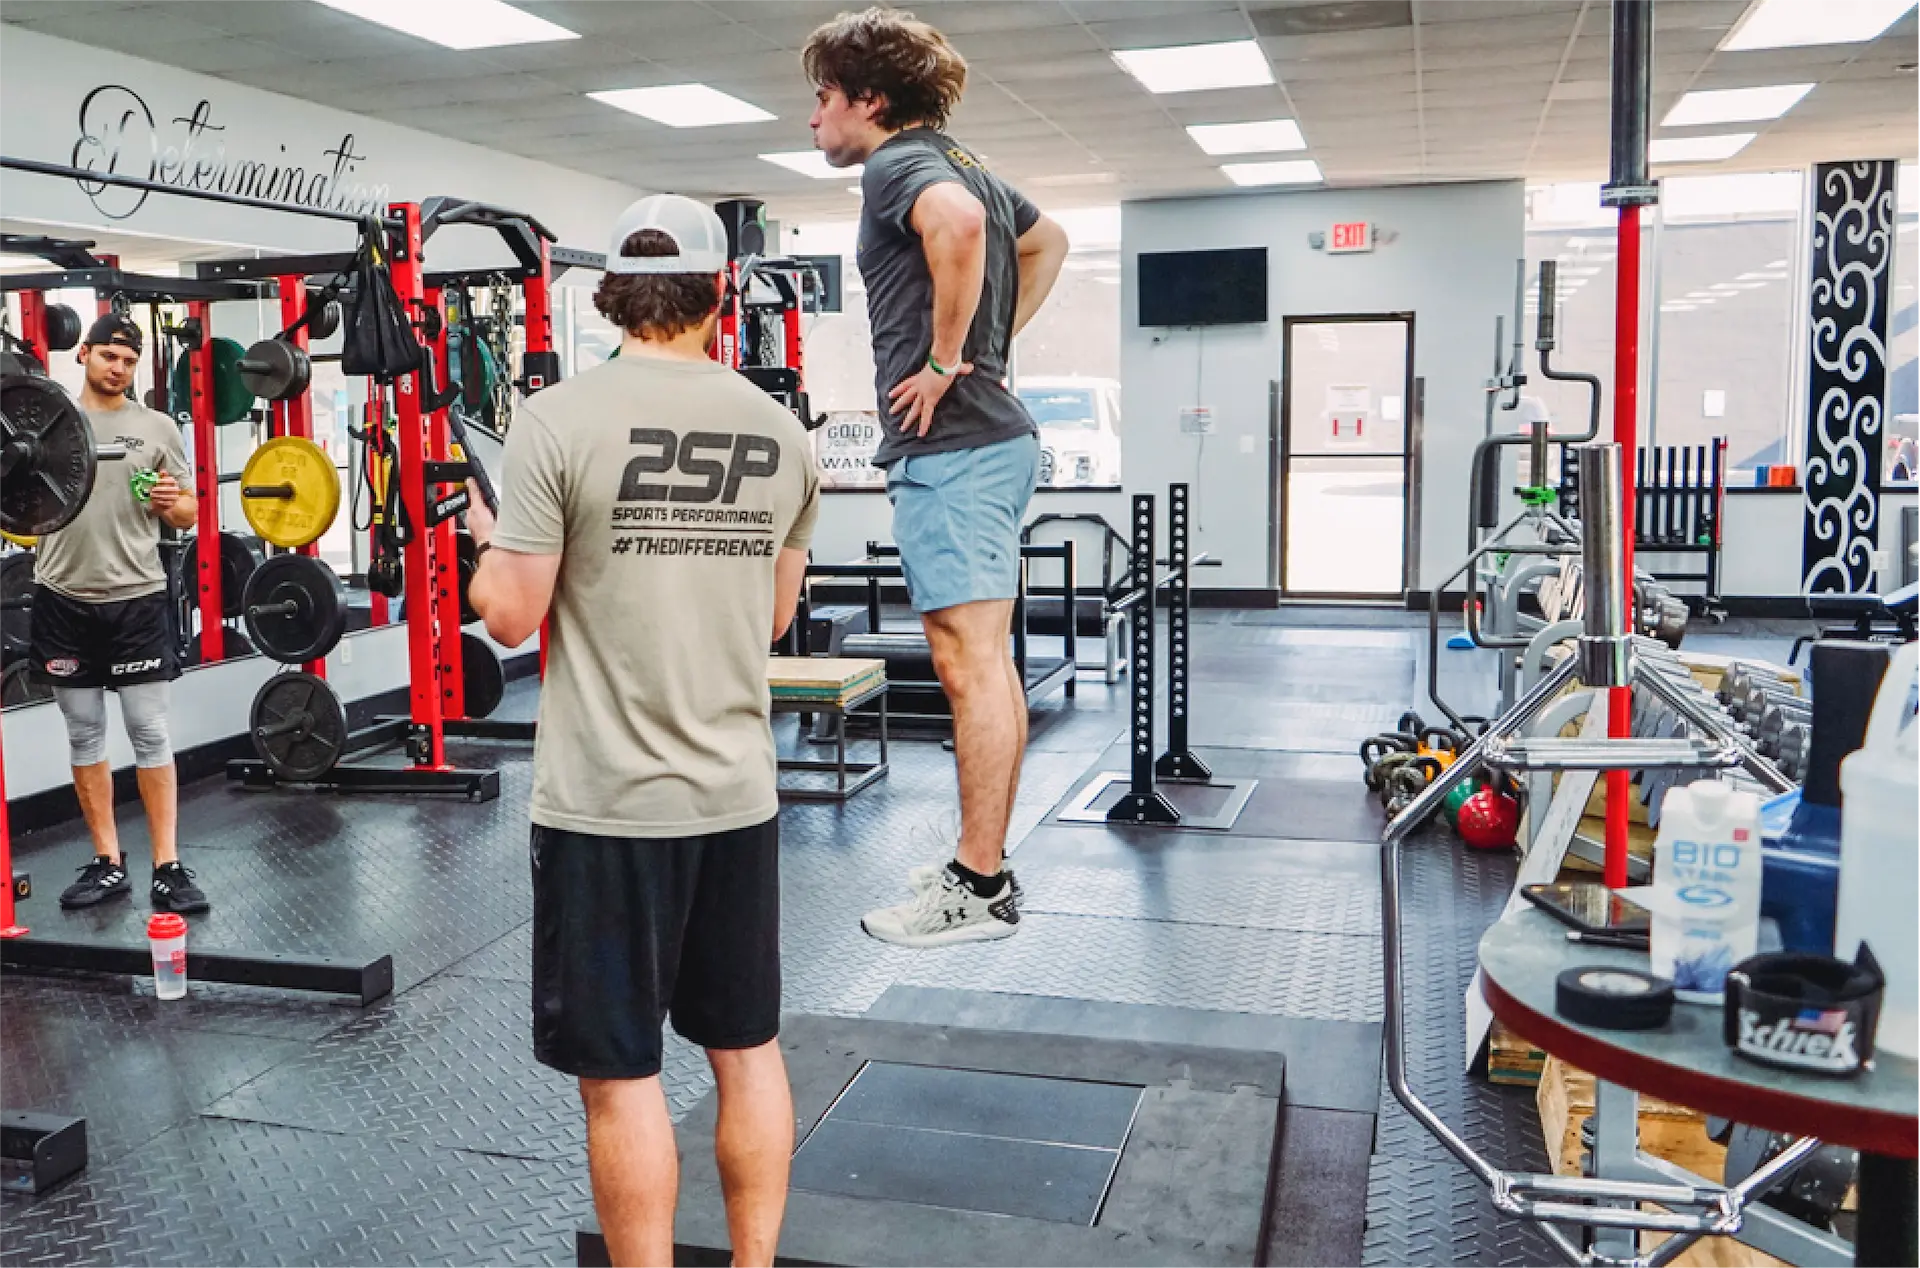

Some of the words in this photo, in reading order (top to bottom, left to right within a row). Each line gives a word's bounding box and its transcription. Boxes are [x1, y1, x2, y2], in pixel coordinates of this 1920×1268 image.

[1332, 222, 1367, 249] EXIT
[827, 423, 873, 439] GOOD
[617, 428, 781, 505] 2SP
[611, 507, 668, 521] SPORTS
[111, 657, 162, 675] CCM
[1672, 839, 1740, 869] BIO
